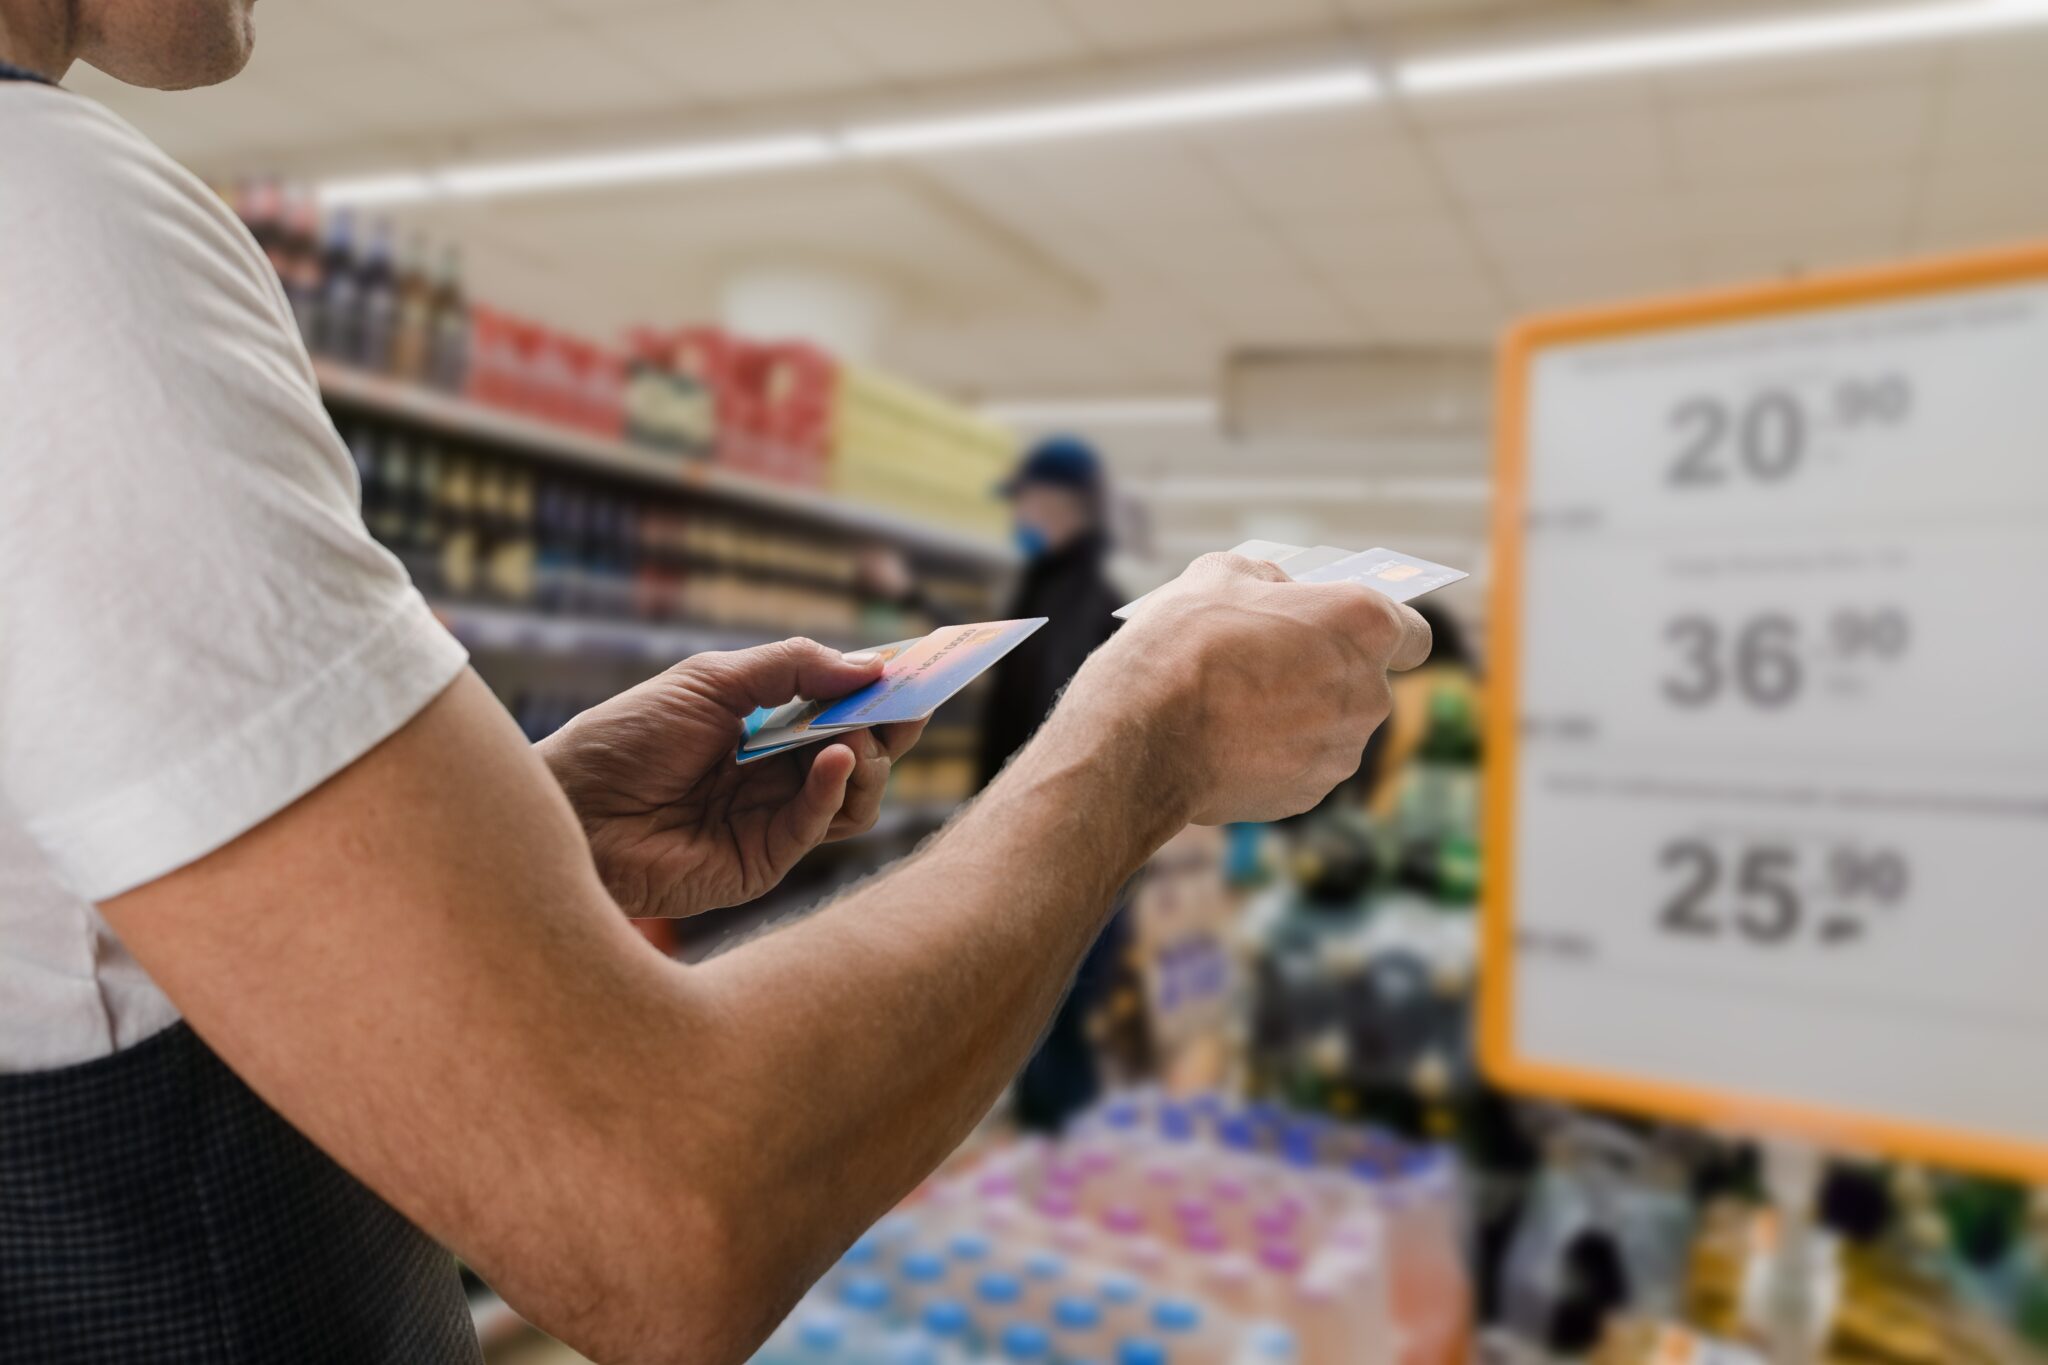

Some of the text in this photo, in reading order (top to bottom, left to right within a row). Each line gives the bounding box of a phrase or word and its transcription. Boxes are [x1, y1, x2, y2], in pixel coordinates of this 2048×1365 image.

[1663, 391, 1804, 486] 20
[1661, 611, 1803, 710] 36
[1656, 836, 1803, 944] 25
